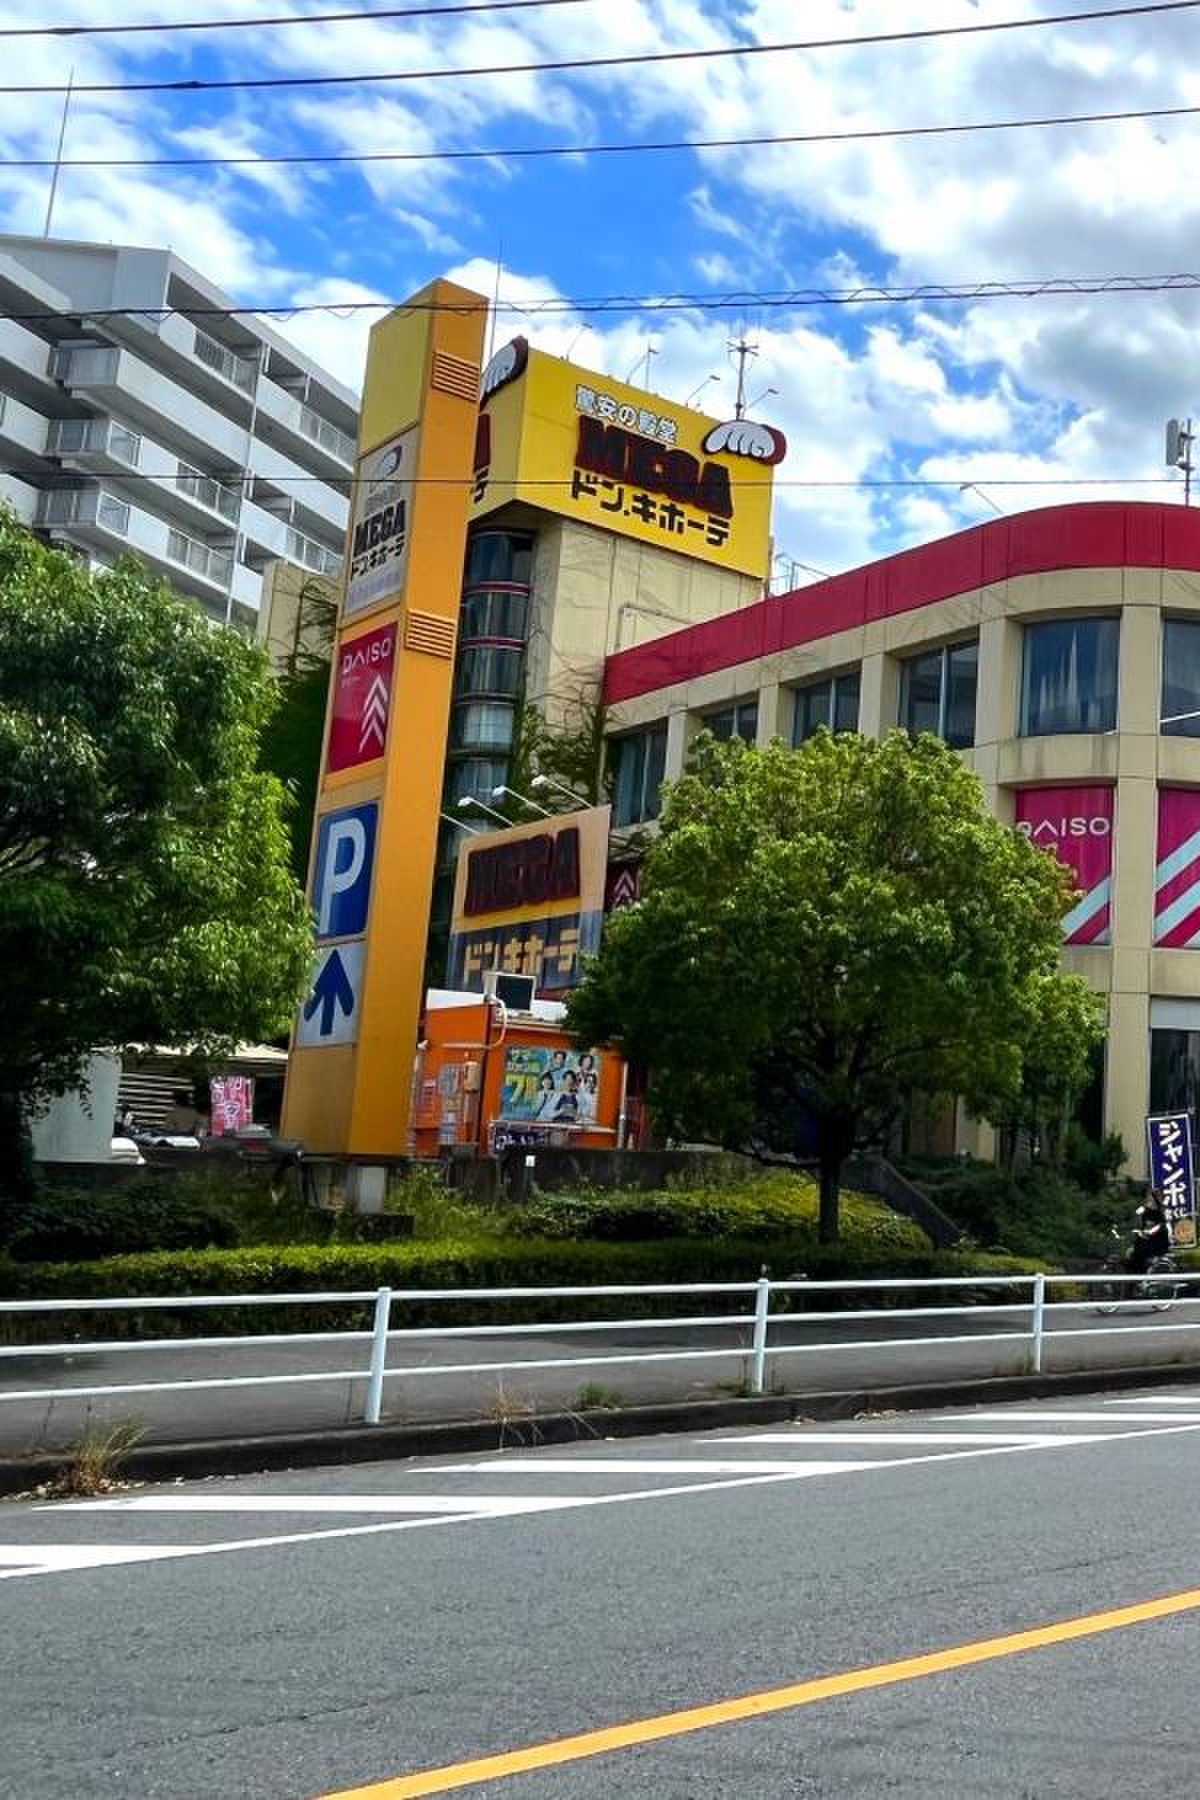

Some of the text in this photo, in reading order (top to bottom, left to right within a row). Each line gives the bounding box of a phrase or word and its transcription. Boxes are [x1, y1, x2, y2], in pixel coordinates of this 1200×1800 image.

[353, 499, 406, 559] MEGA
[343, 637, 392, 674] DAISO
[1016, 816, 1110, 837] DAISO
[319, 818, 366, 935] P
